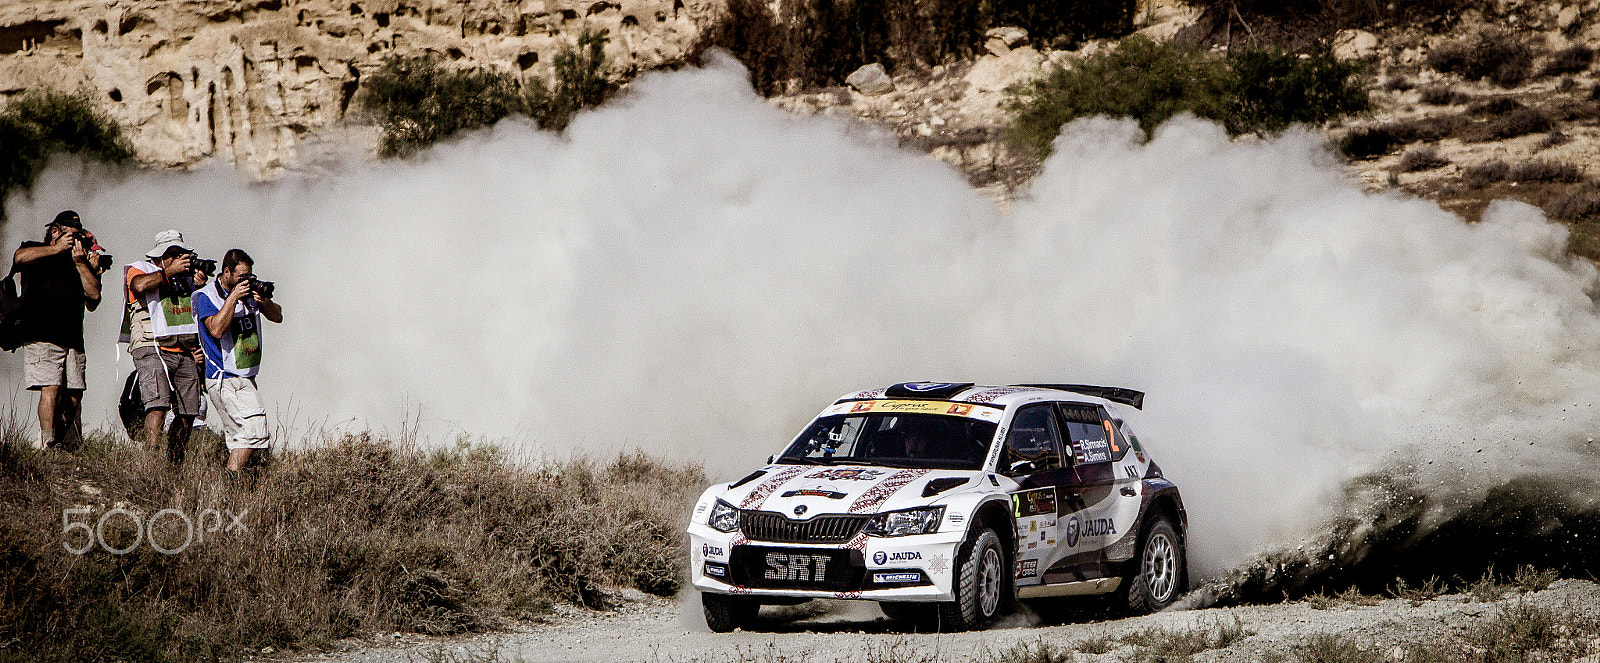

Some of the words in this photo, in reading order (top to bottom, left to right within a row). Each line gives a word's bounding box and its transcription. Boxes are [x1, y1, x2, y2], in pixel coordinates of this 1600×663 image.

[238, 317, 253, 331] 18
[881, 401, 929, 411] Cyprus
[1103, 419, 1120, 452] 2
[1012, 493, 1020, 518] 2
[1081, 518, 1117, 538] JAUDA
[889, 552, 922, 561] JAUDA
[764, 552, 832, 581] SRT
[885, 573, 920, 581] MICHELIN
